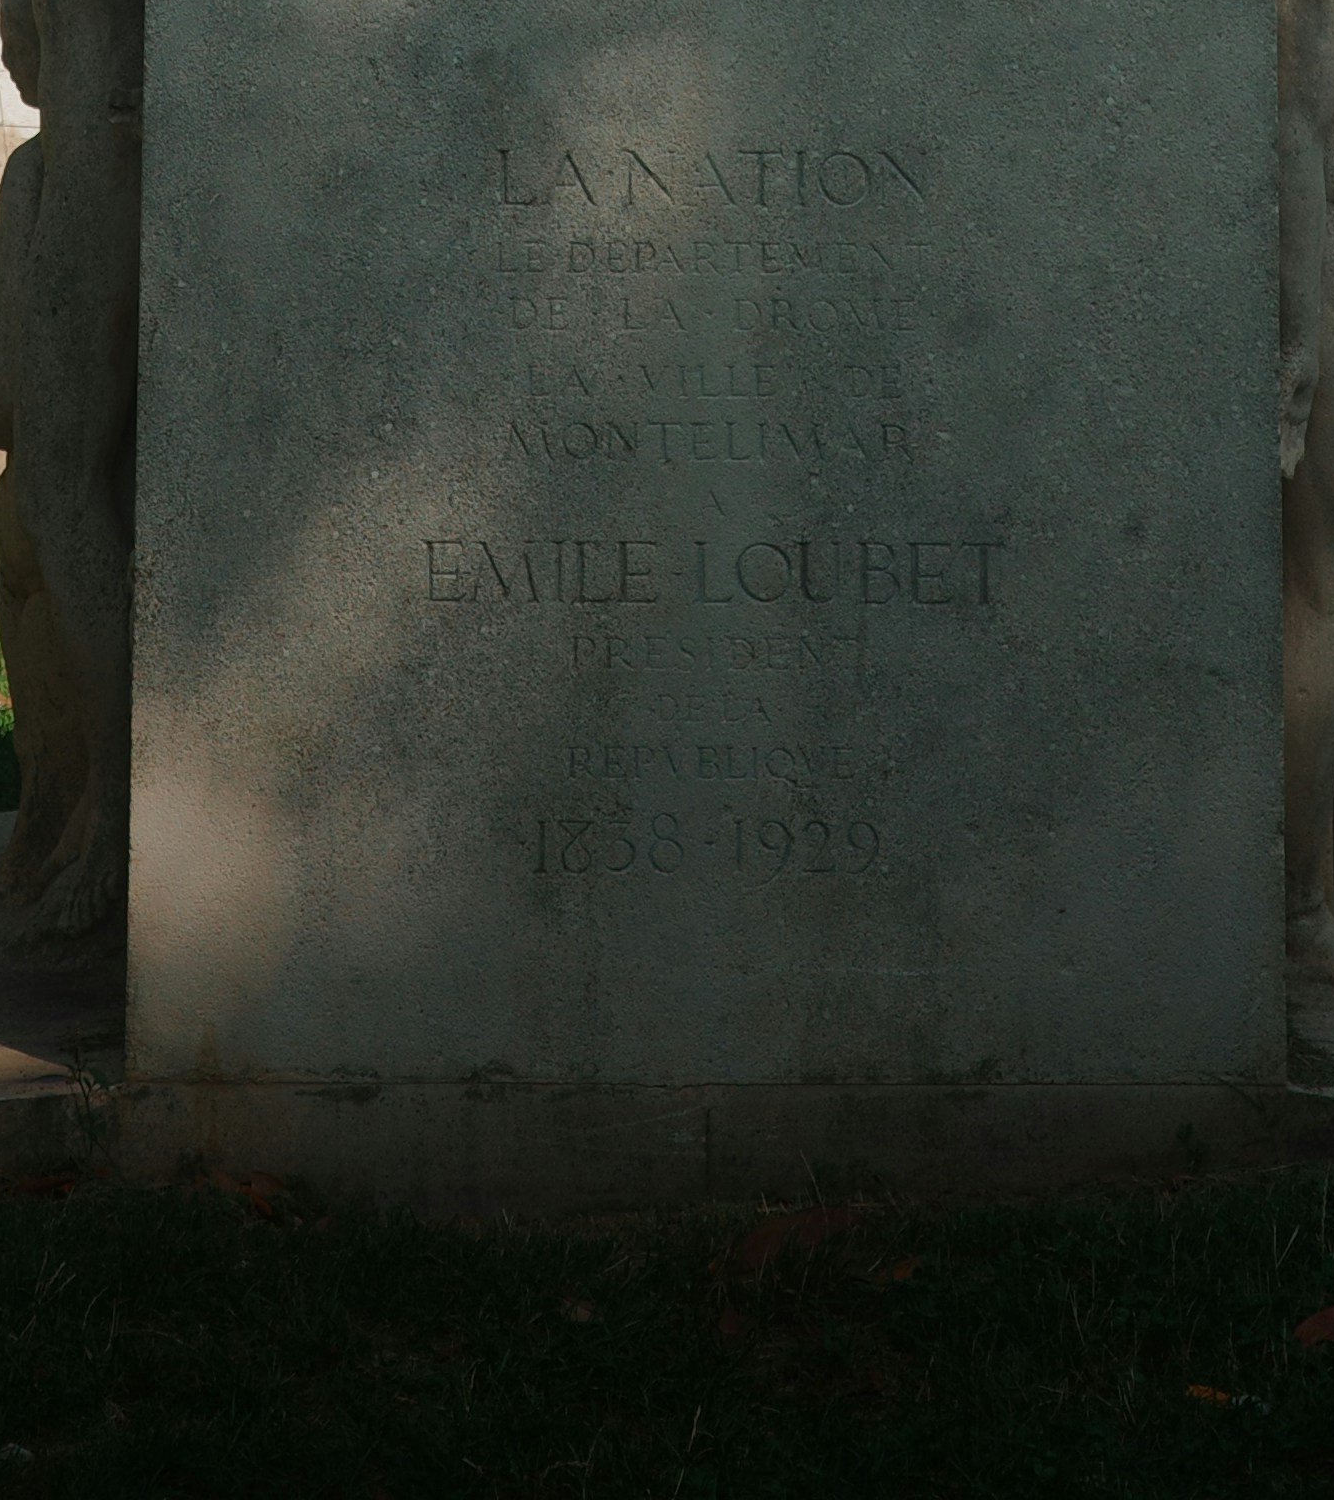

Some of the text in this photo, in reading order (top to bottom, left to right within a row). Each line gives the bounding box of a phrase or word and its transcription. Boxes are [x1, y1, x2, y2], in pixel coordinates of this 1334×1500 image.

[497, 147, 936, 207] LA NATION
[497, 239, 547, 273] LE
[509, 296, 571, 331] DE
[620, 297, 686, 331] LA
[526, 363, 905, 399] LA VILLE DE
[508, 420, 918, 465] MONTELIMAR
[421, 537, 1007, 605] EMILE LOUBET
[654, 690, 773, 723] DE LA
[532, 811, 883, 886] 1838 1929
